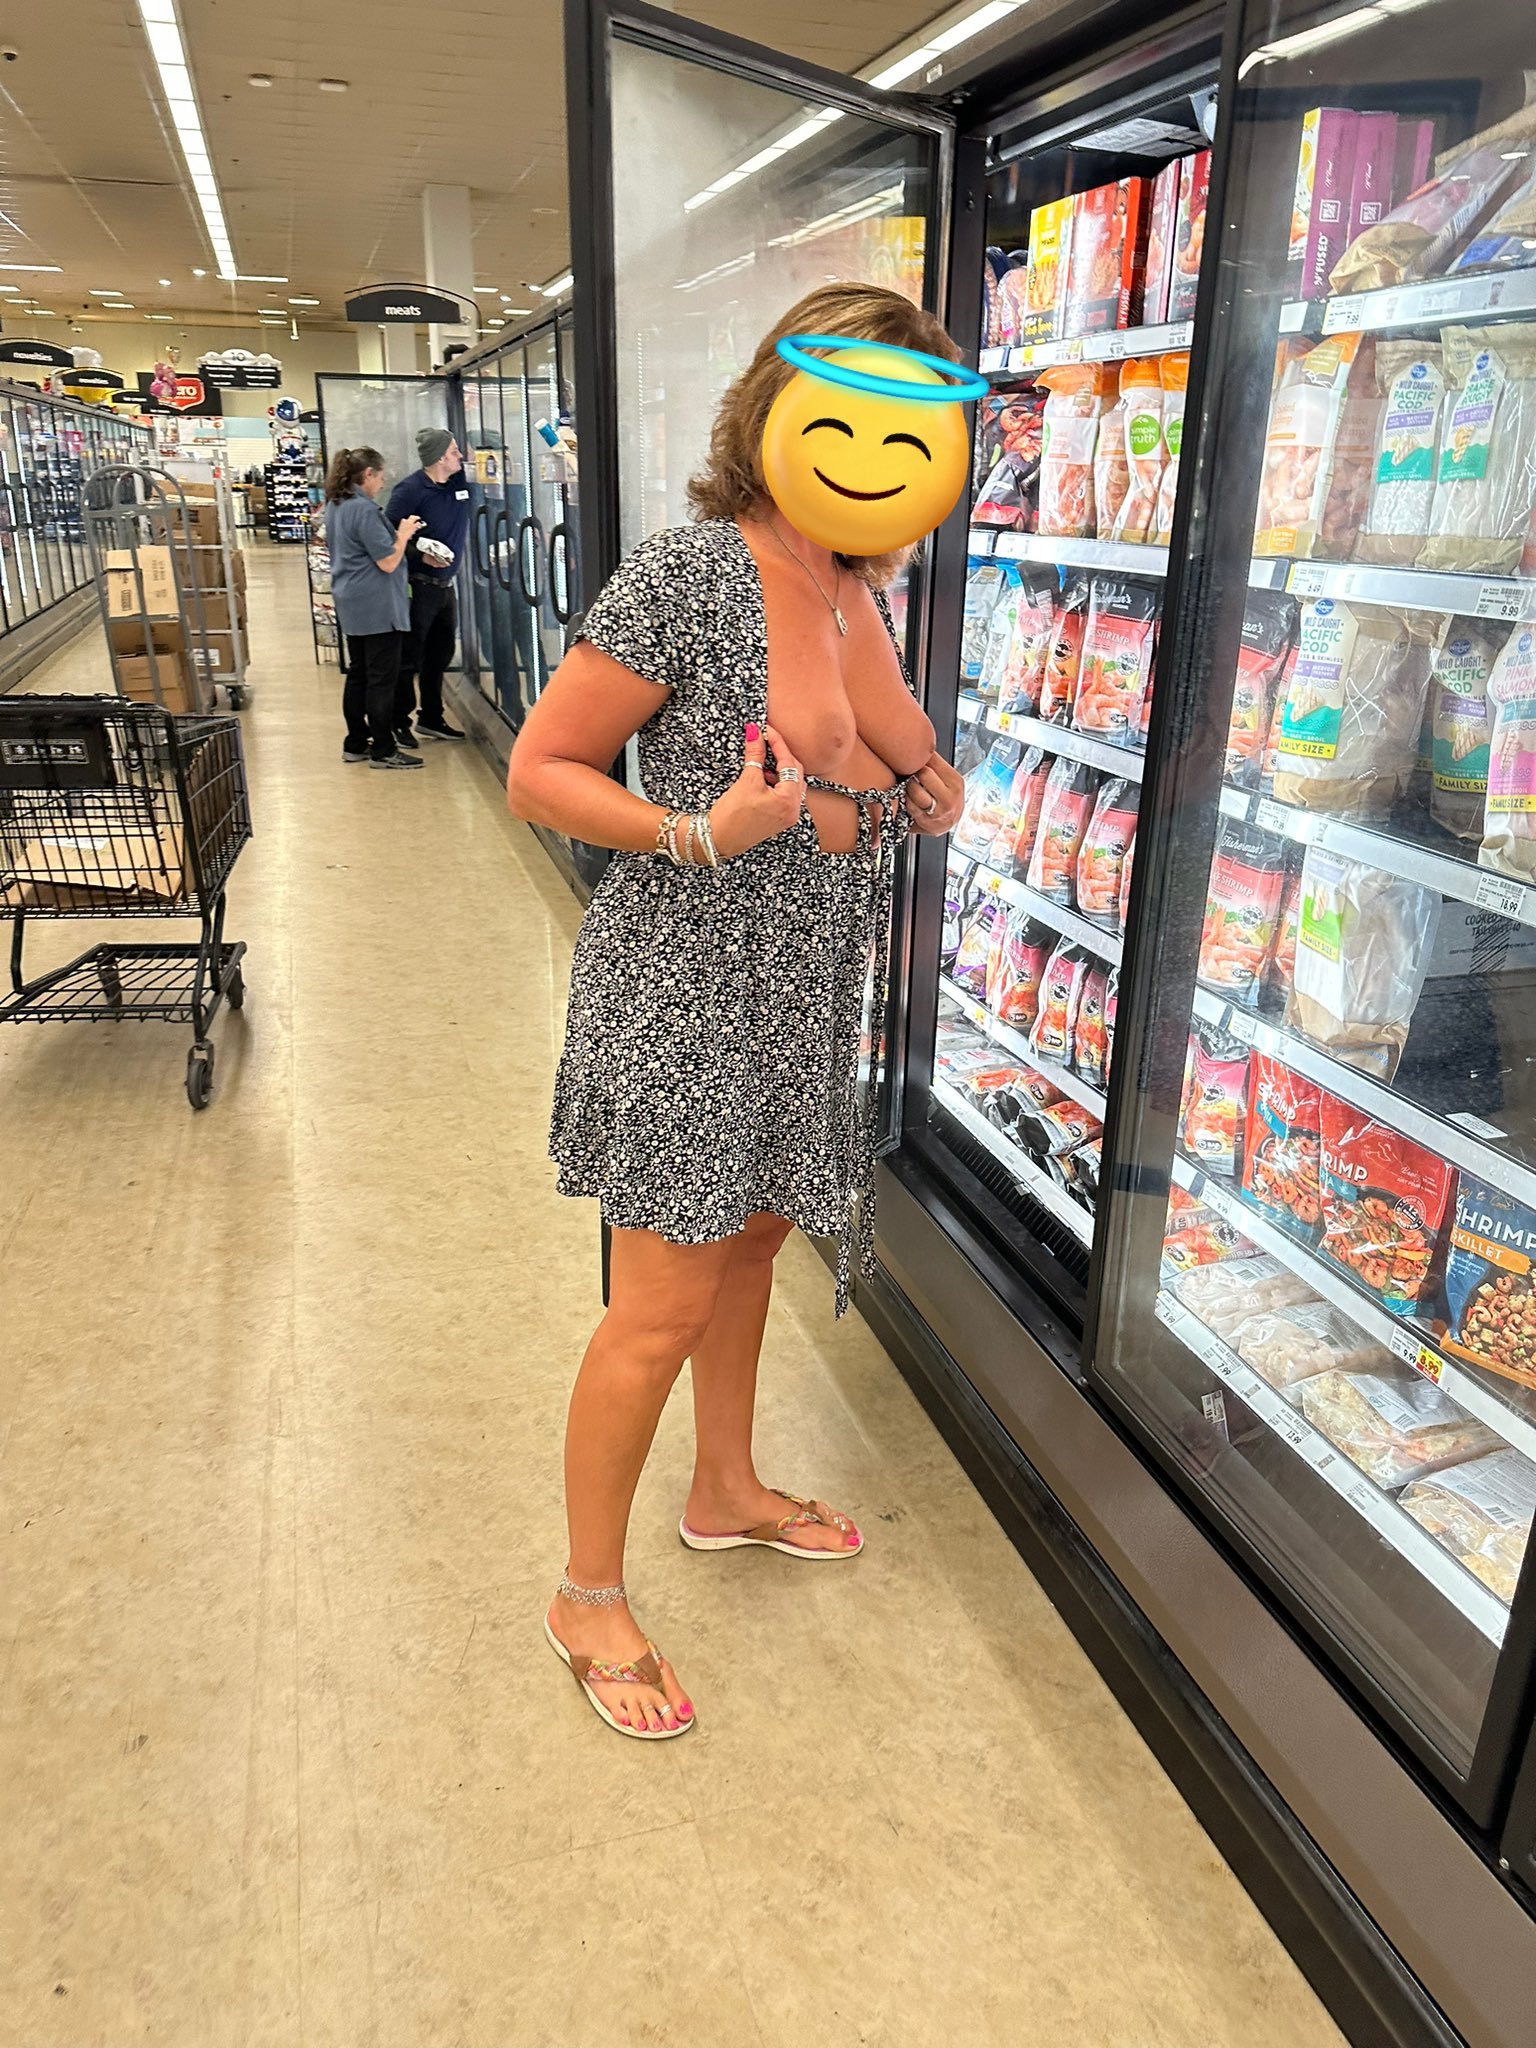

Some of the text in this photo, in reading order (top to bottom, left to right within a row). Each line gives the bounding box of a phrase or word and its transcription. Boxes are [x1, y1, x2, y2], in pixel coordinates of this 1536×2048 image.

[385, 305, 421, 316] meats
[13, 351, 53, 361] novelties
[1394, 390, 1436, 400] PACIFIC
[1397, 401, 1422, 410] COD
[1131, 433, 1156, 444] truth
[1500, 604, 1519, 617] 9.99
[1096, 628, 1130, 645] SHRIMP
[1302, 629, 1342, 643] ACIFIC
[1301, 641, 1329, 654] COD
[1455, 656, 1482, 669] CAUGHT
[1505, 666, 1532, 680] PINK
[1447, 682, 1473, 693] COD
[1302, 744, 1325, 755] SIZE
[1439, 777, 1488, 791] FAMILY SIZ
[1222, 874, 1254, 897] SHRIMP
[1501, 898, 1519, 913] 18.99
[1322, 1153, 1368, 1183] RIMP
[1408, 1204, 1419, 1216] 12
[1452, 1229, 1504, 1260] SKILLET
[1403, 1348, 1417, 1364] 9.99
[1217, 1362, 1232, 1376] 7.99
[1420, 1354, 1439, 1375] 8.99
